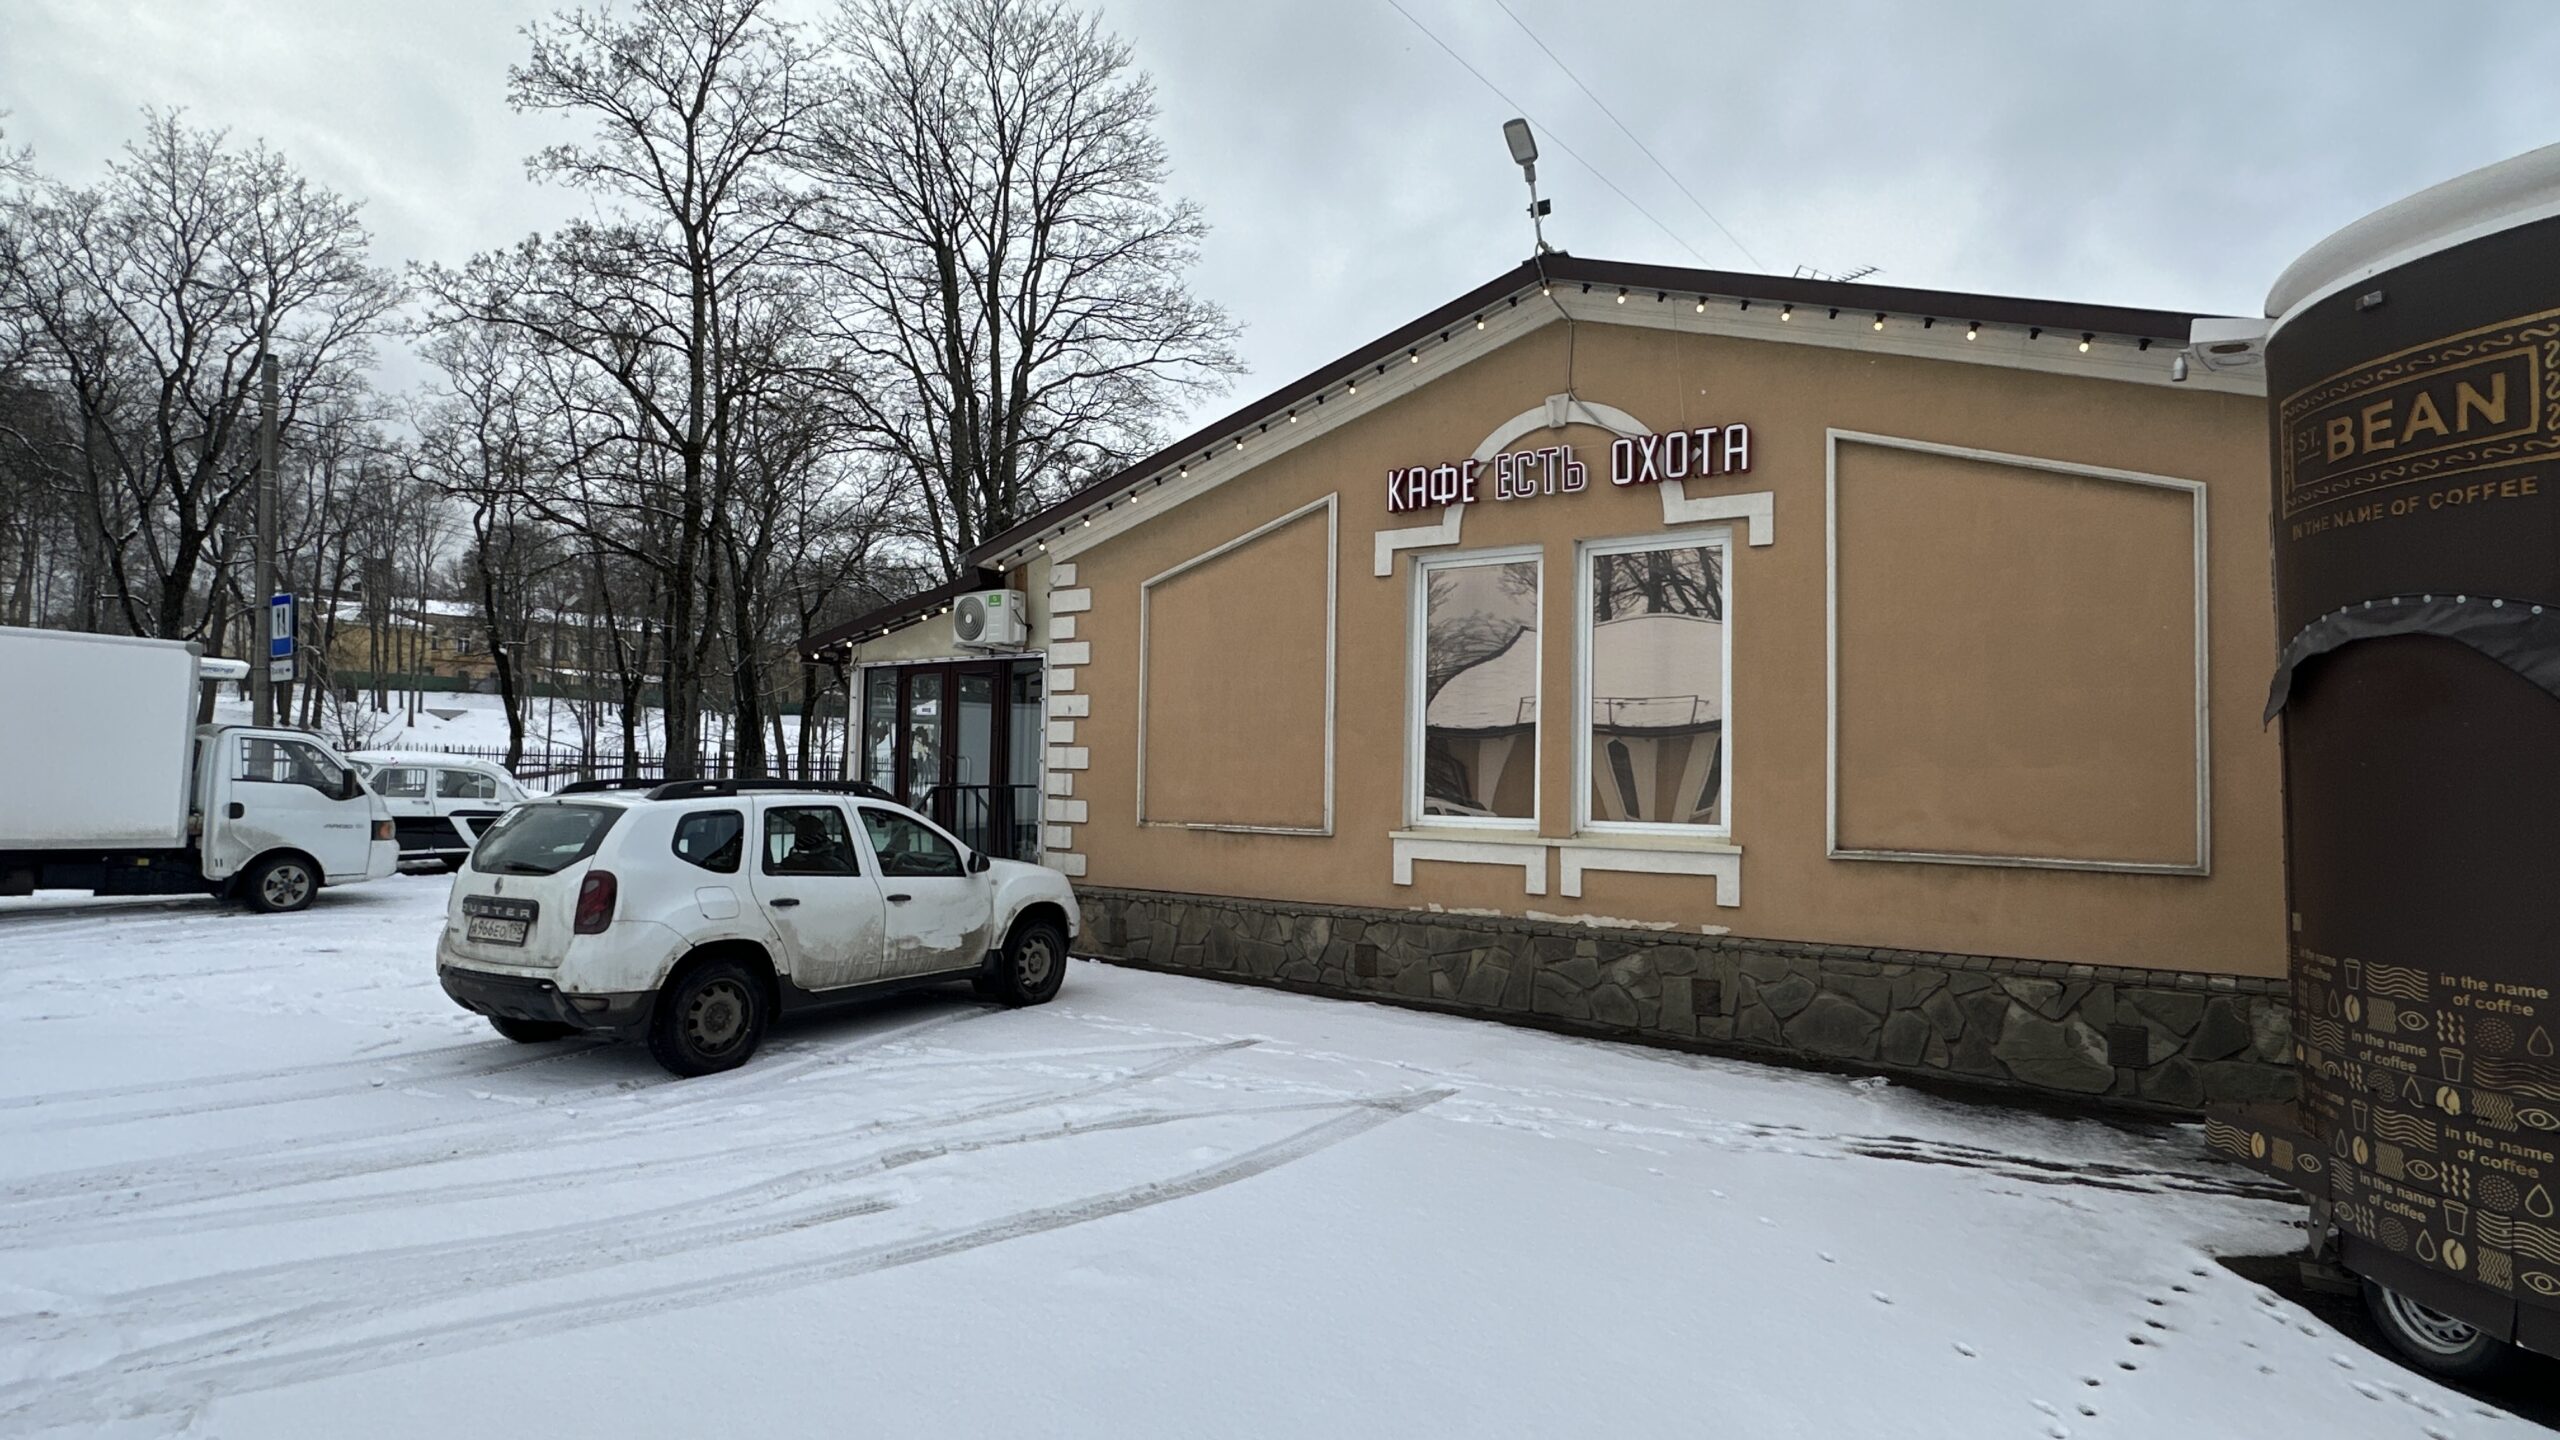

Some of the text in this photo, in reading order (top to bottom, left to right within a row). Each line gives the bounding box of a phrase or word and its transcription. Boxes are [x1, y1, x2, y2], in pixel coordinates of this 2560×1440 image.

[2326, 372, 2507, 465] BEAN
[1387, 423, 1752, 511] КАФЕ ЕСТЬ ОХОТА
[2292, 476, 2538, 541] IN THE NAME OF COFFEE
[2440, 972, 2549, 999] in the name
[2452, 994, 2534, 1016] of coffee
[2351, 1029, 2427, 1057] in the name
[2360, 1050, 2417, 1073] of coffee
[2445, 1125, 2554, 1163] in the name
[2457, 1149, 2539, 1179] of coffee
[2360, 1171, 2436, 1208] in the name
[2368, 1194, 2426, 1222] of coffee
